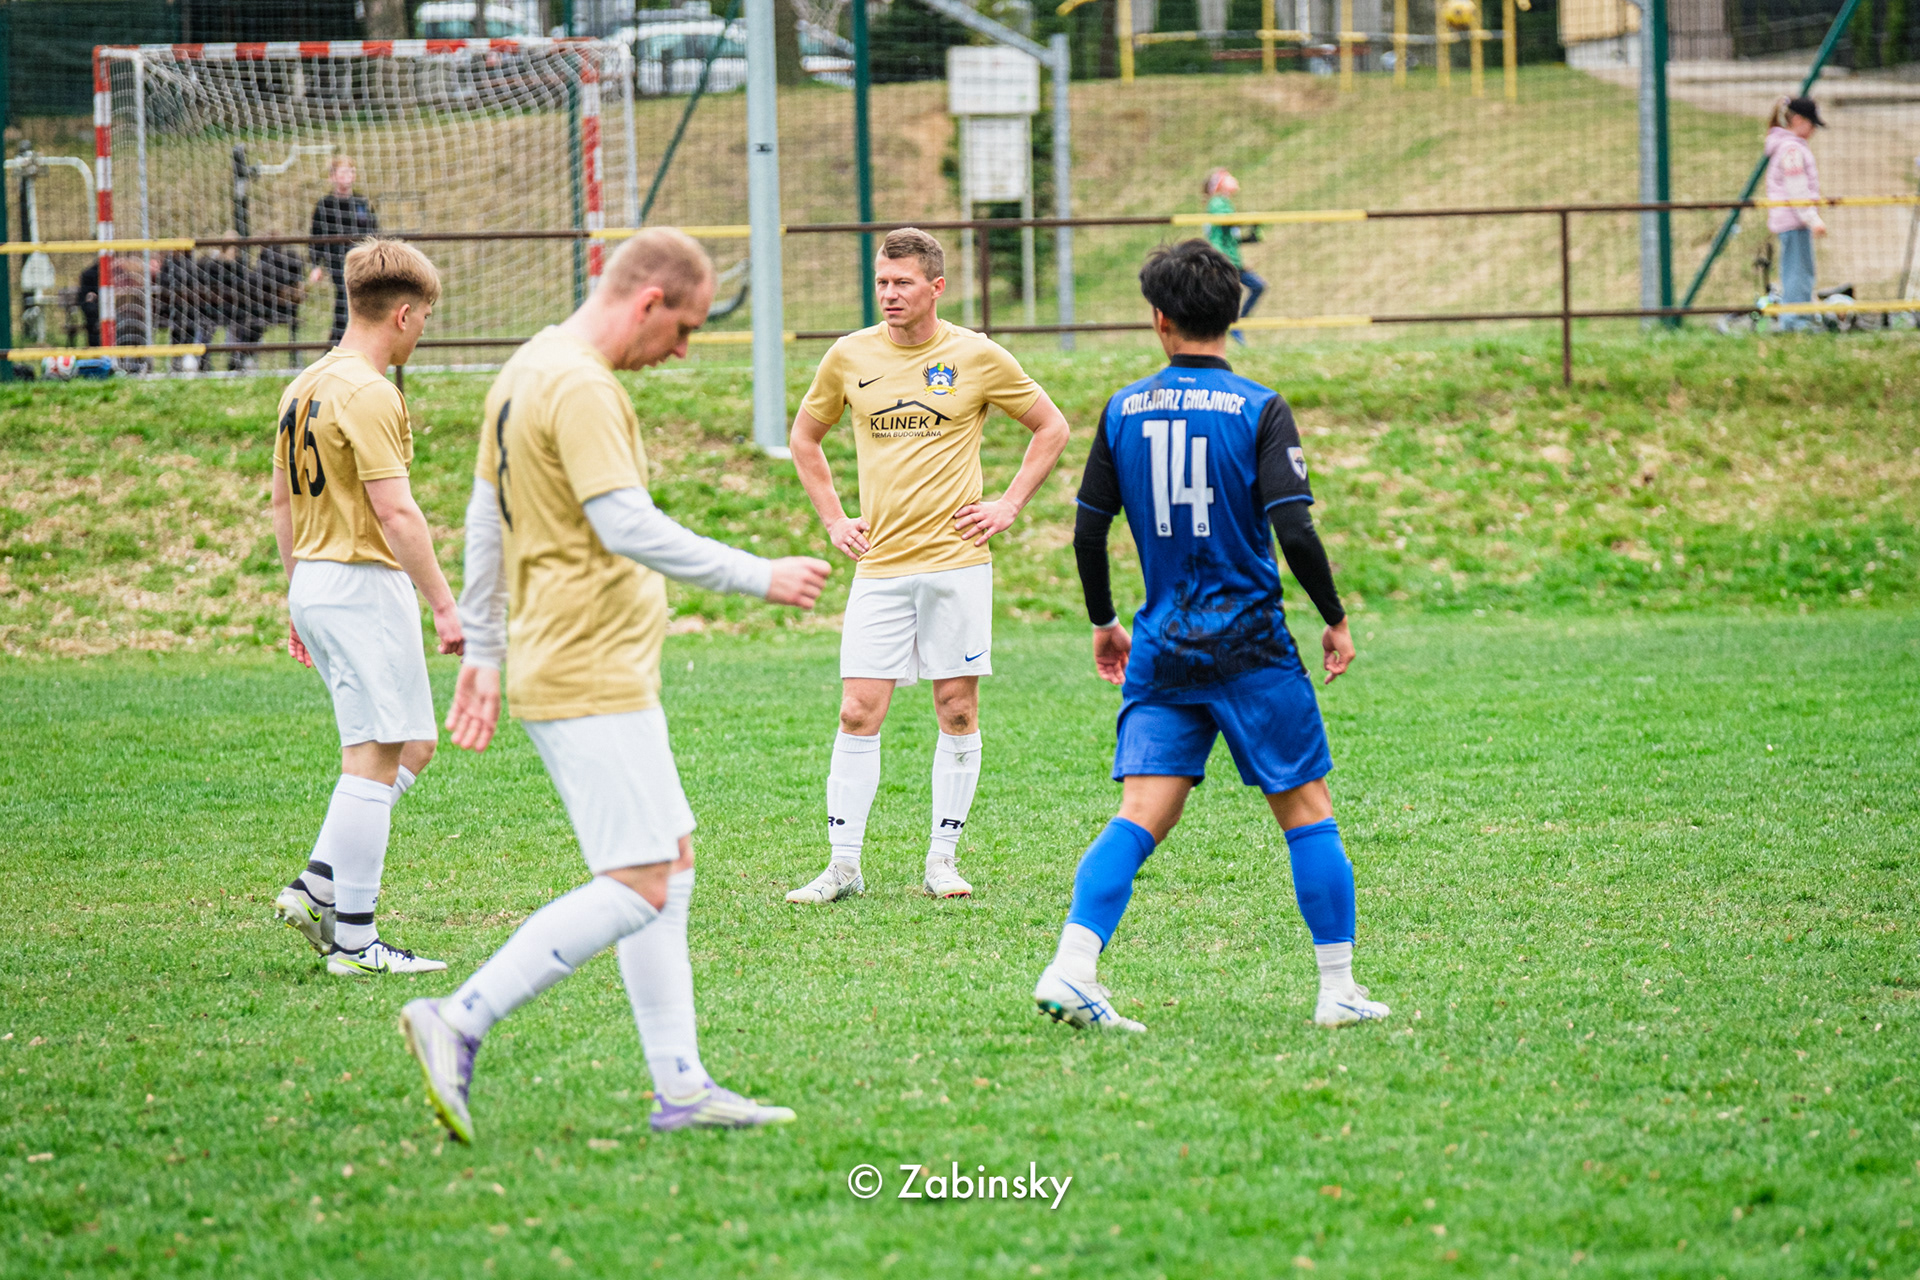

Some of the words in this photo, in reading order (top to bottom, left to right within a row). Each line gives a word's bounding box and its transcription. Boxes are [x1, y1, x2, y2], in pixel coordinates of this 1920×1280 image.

[1121, 388, 1182, 416] KOLEJARZ
[1182, 388, 1246, 415] CHOJNICE
[870, 416, 931, 430] KLINEK
[893, 430, 942, 438] BUDOWLANA
[279, 397, 327, 498] 15
[1142, 419, 1215, 538] 14
